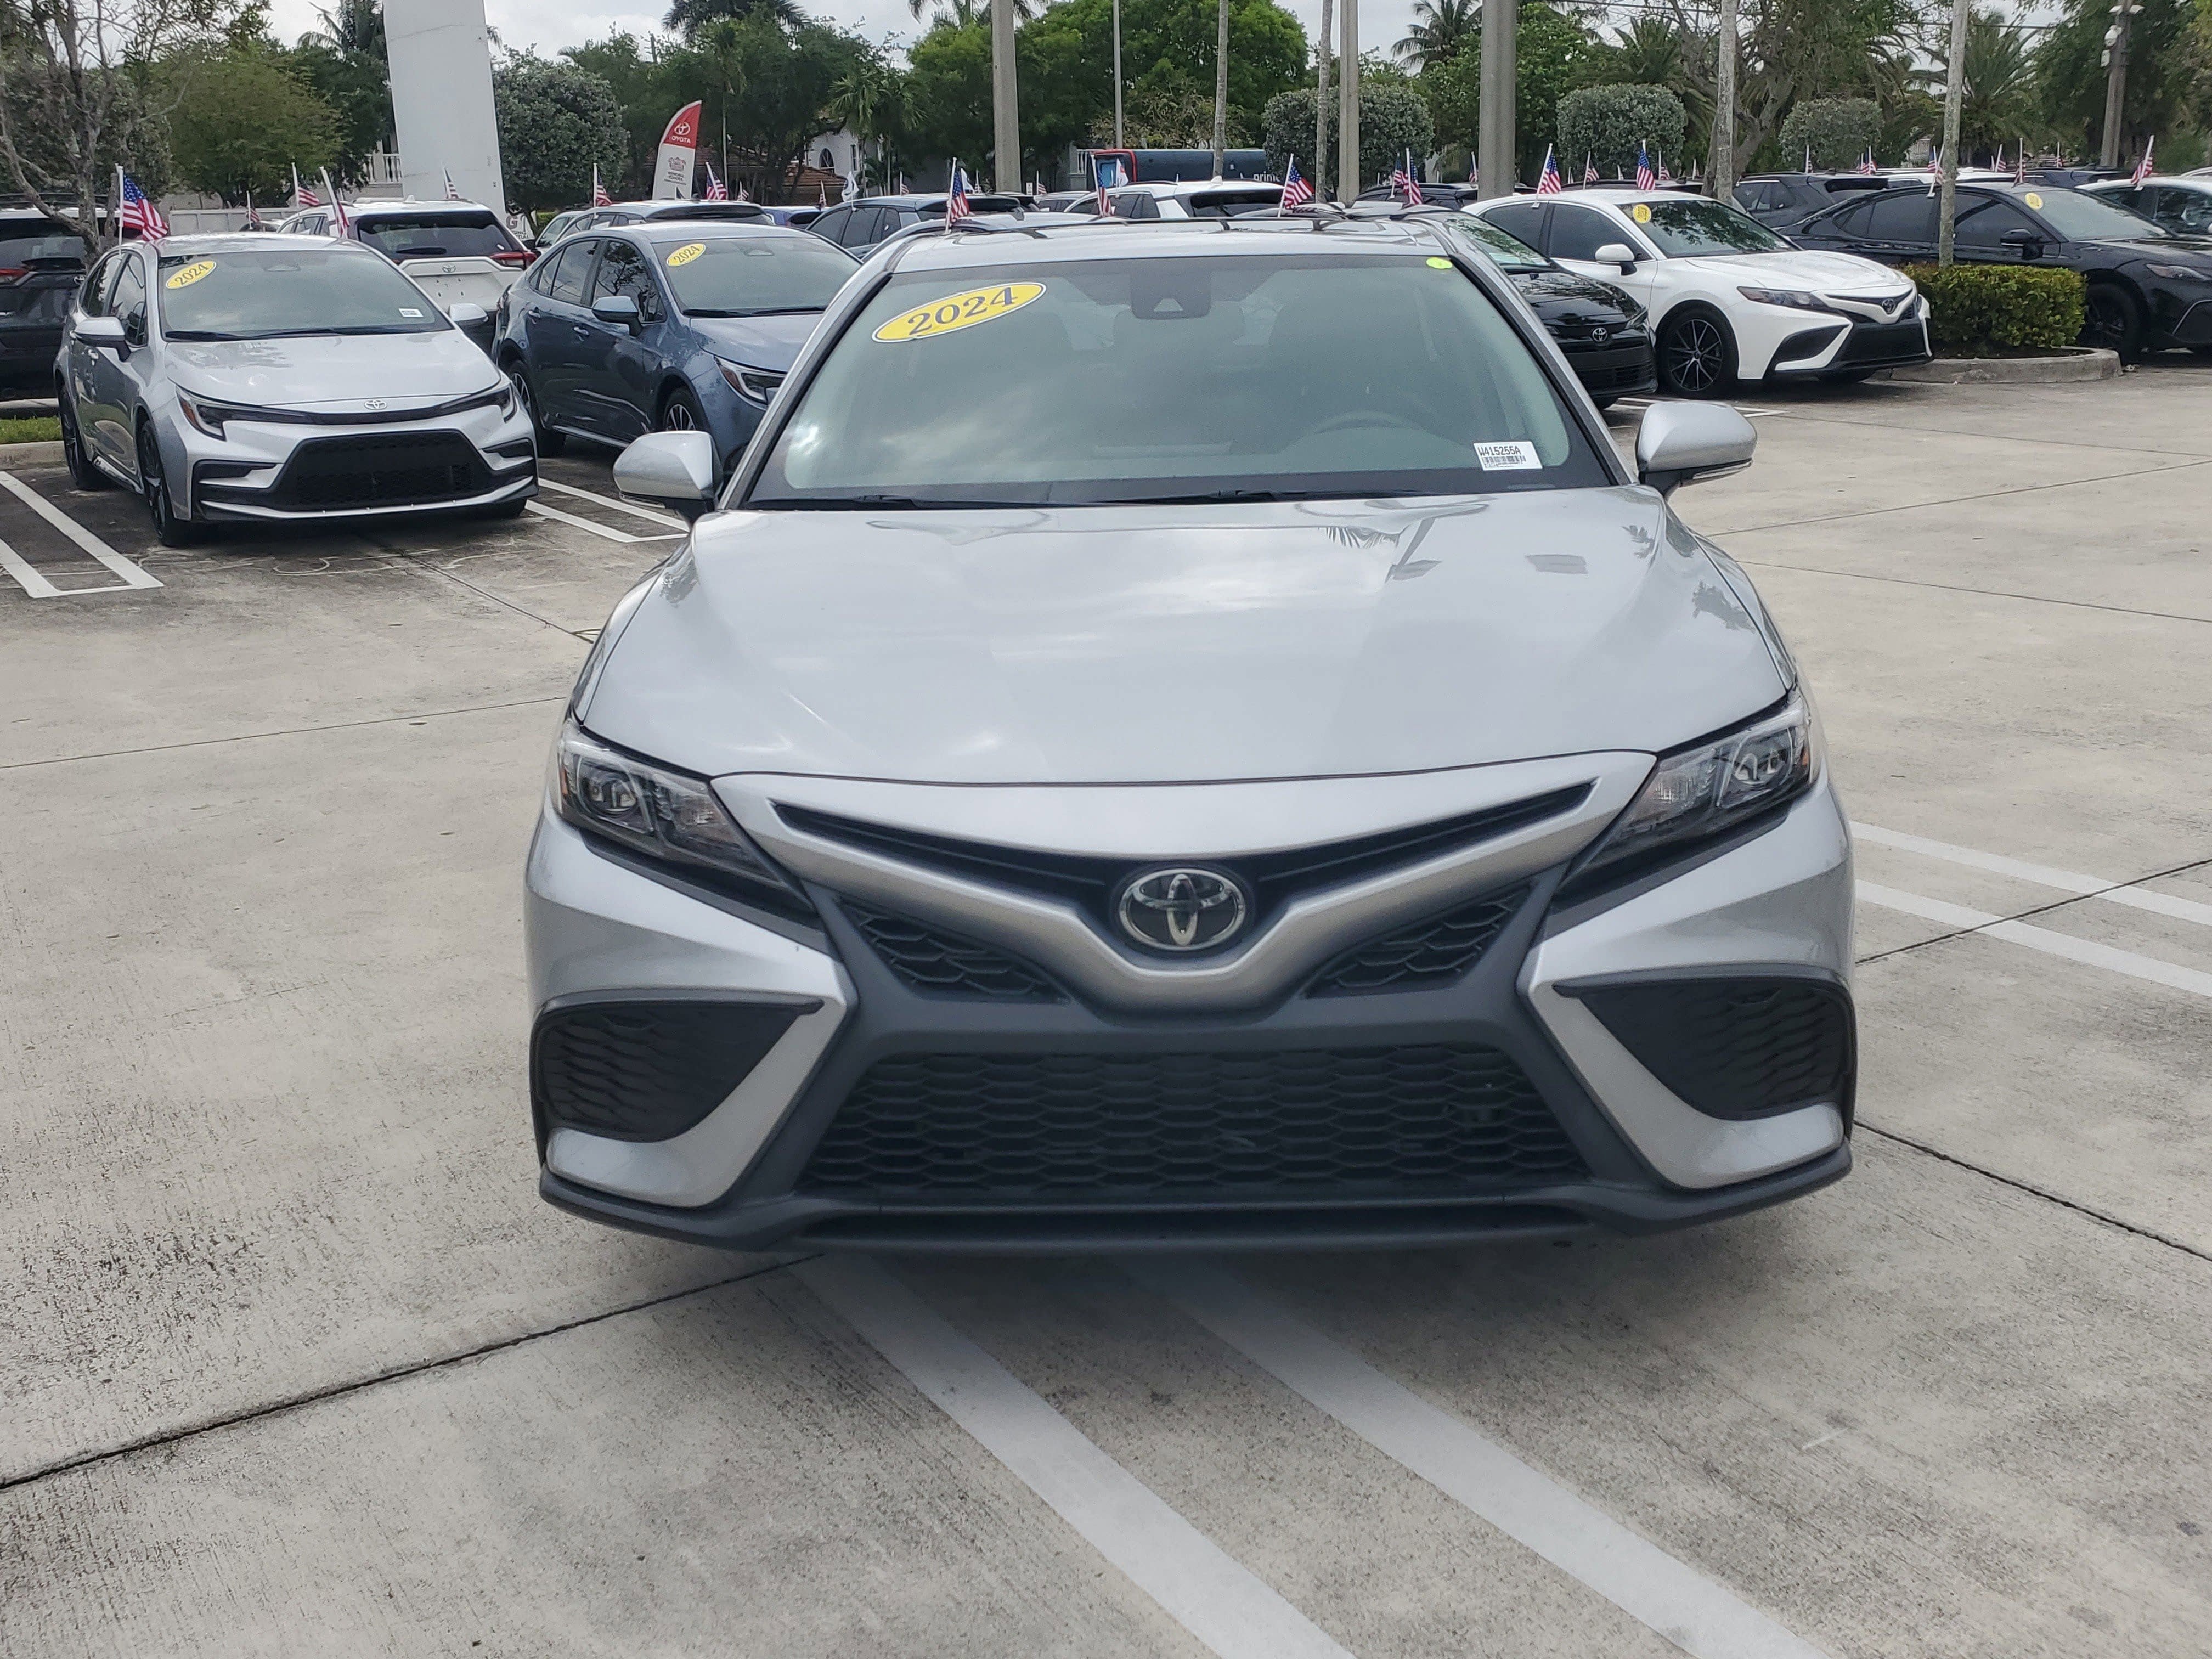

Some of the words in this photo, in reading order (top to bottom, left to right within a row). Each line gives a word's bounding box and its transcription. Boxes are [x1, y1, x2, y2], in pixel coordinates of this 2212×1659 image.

[674, 246, 700, 263] 2024
[175, 264, 209, 285] 2024
[907, 287, 1018, 336] 2024
